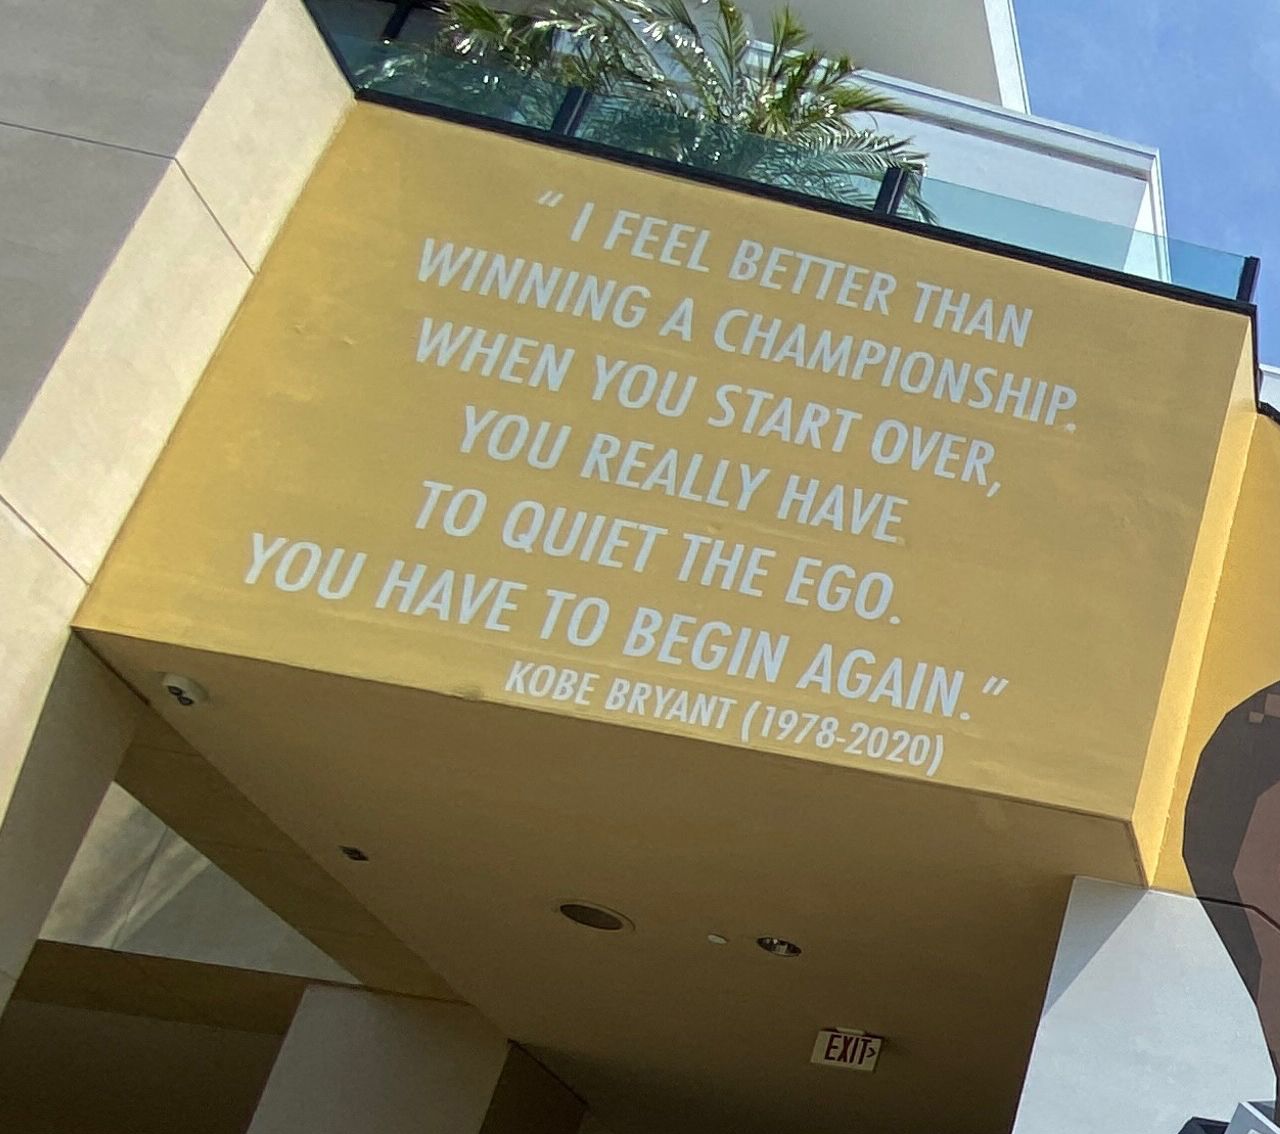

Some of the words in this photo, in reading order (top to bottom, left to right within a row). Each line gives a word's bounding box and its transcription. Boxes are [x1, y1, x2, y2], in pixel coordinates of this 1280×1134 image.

[417, 238, 651, 330] WINNING
[659, 298, 694, 342] A
[713, 307, 1078, 432] CHAMPIONSHIP.
[602, 209, 710, 273] FEEL
[728, 239, 897, 313] BETTER
[913, 281, 1033, 347] THAN
[414, 318, 575, 392] WHEN
[590, 354, 698, 417] YOU
[708, 383, 860, 452] START
[870, 418, 1002, 498] OVER,
[460, 405, 572, 470] YOU
[580, 432, 769, 512] REALLY
[776, 474, 906, 543] HAVE
[243, 532, 367, 600] YOU
[375, 559, 527, 632] HAVE
[538, 588, 611, 648] TO
[622, 607, 791, 683] BEGIN
[414, 480, 487, 537] TO
[502, 500, 668, 574] QUIET
[677, 533, 775, 597] THE
[784, 556, 902, 627] EGO.
[504, 660, 600, 706] KOBE
[604, 677, 738, 731] BRYANT
[740, 699, 945, 778] (1978-2020)
[824, 1034, 872, 1065] EXIT
